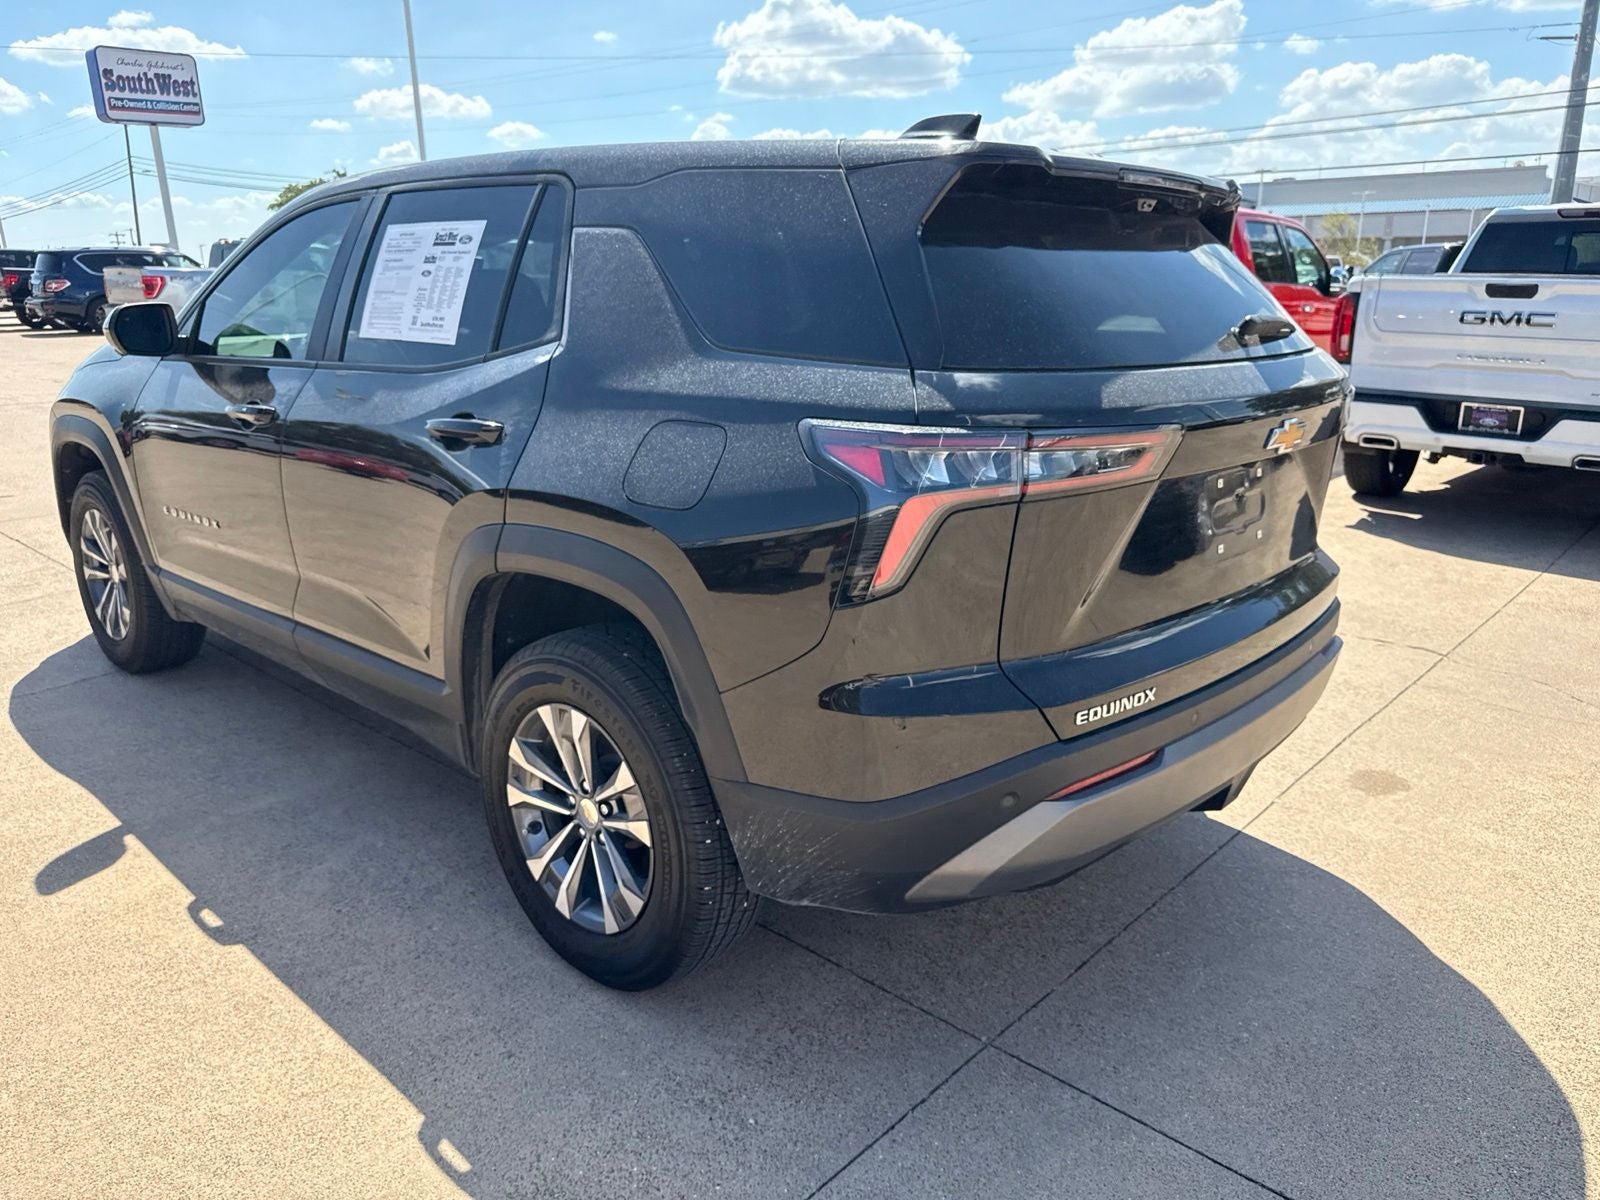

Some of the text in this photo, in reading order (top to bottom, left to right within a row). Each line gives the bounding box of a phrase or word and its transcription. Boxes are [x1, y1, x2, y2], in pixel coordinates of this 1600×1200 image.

[110, 98, 146, 109] Pre-Owned
[180, 103, 200, 112] Center
[1459, 311, 1556, 328] GMC
[163, 506, 221, 529] EQUINOX
[1075, 687, 1157, 726] EQUINOX
